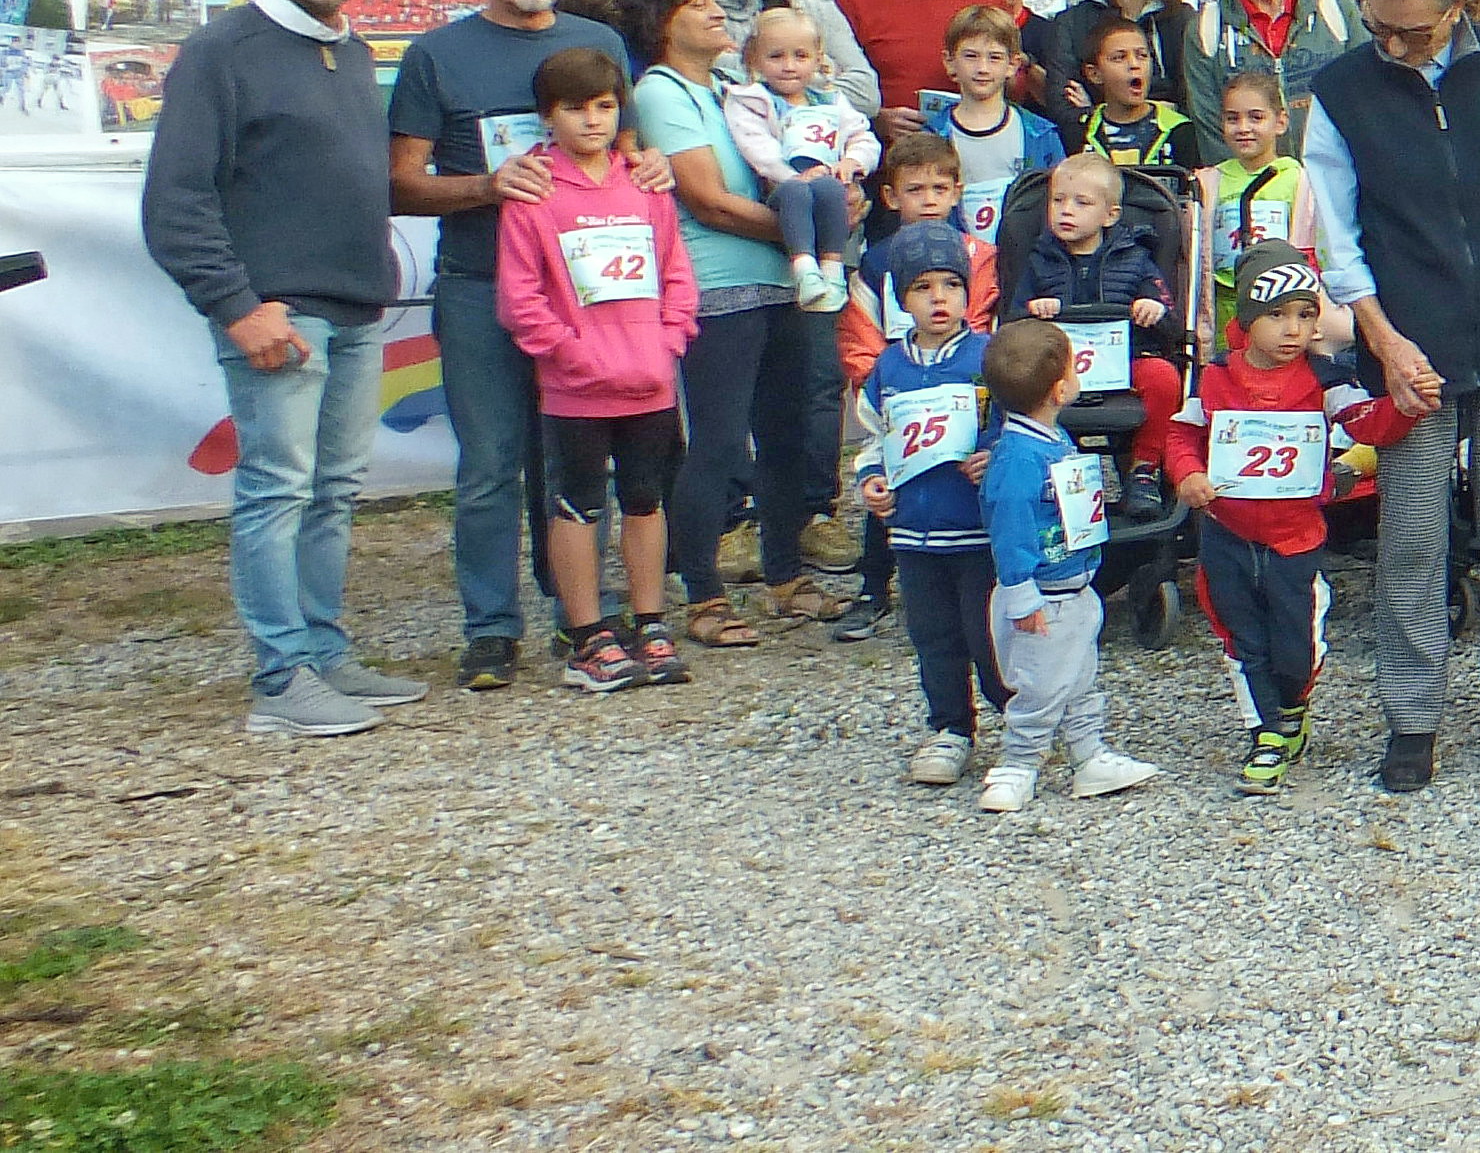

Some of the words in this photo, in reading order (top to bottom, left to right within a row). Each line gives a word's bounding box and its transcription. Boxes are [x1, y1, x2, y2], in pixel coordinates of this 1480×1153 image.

[803, 124, 837, 150] 34
[974, 205, 996, 231] 9
[600, 254, 646, 281] 42
[902, 413, 950, 460] 25
[1237, 445, 1299, 478] 23
